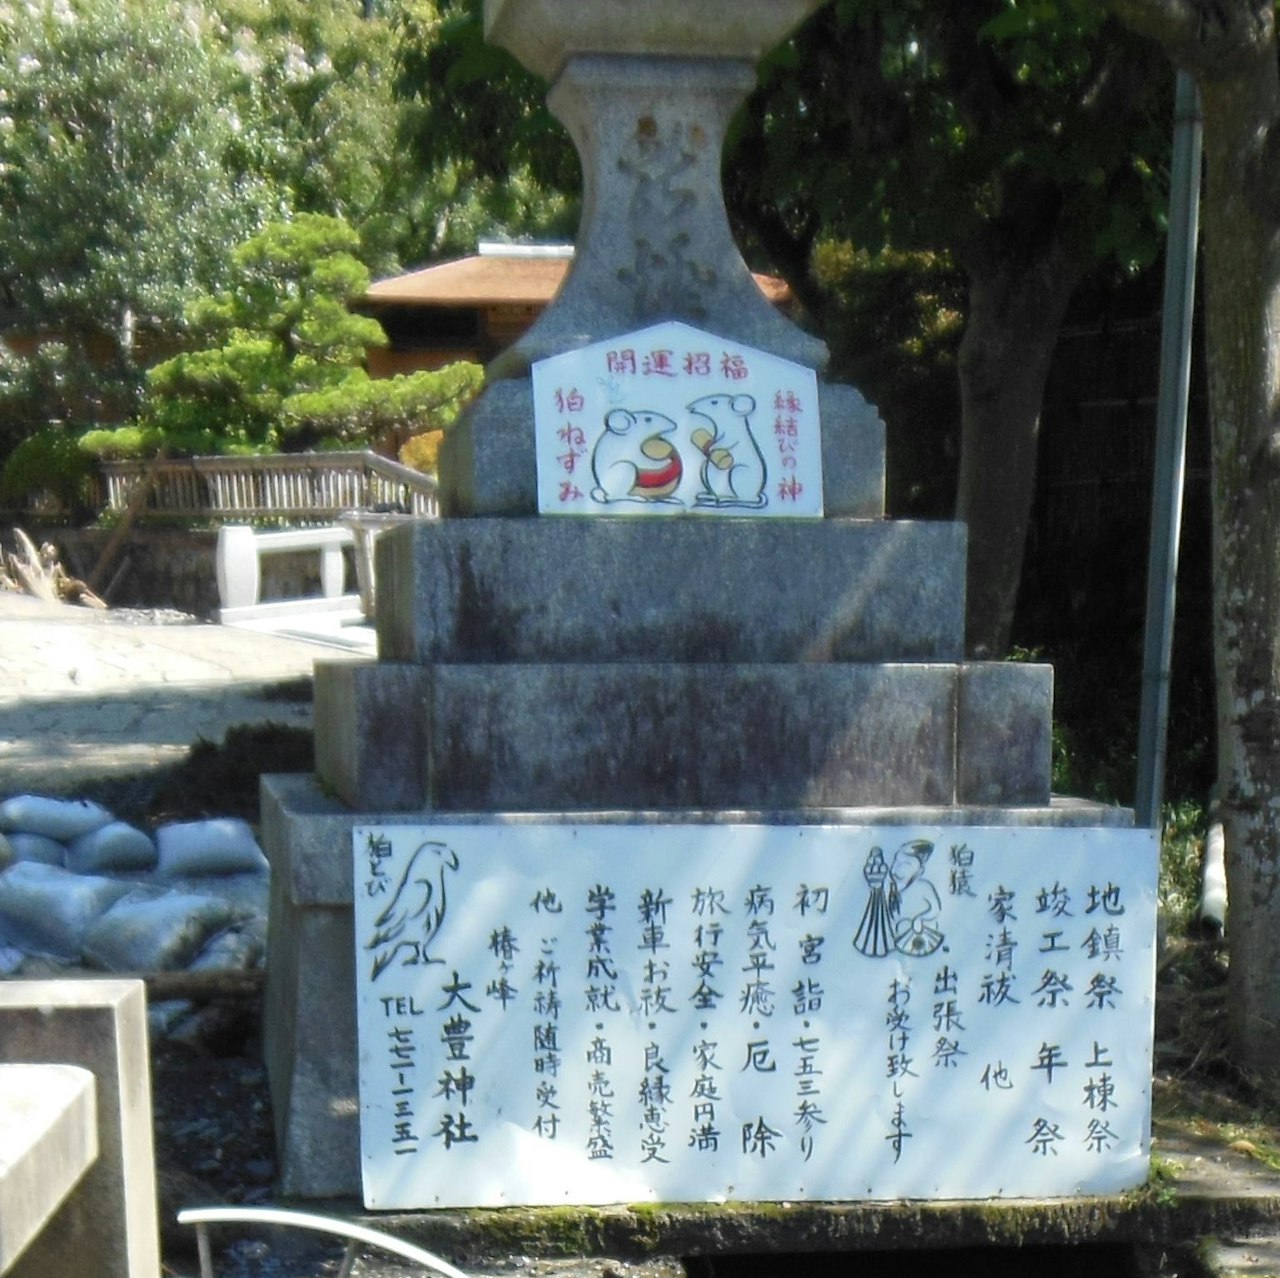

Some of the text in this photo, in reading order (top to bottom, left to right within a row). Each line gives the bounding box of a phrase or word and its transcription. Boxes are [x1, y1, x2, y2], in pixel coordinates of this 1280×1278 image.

[606, 349, 749, 379] 開運招福
[554, 387, 587, 502] 狛ねずみ
[773, 390, 803, 501] 縁結びの神
[363, 832, 392, 897] 狛とび
[531, 888, 563, 914] 他
[1031, 881, 1074, 1009] 竣工祭
[380, 997, 424, 1016] TEL
[432, 971, 481, 1150] 大豊神社
[1080, 881, 1125, 1152] 地鎮祭 上棟祭
[885, 977, 919, 1164] お受け致します
[980, 1060, 1013, 1090] 他
